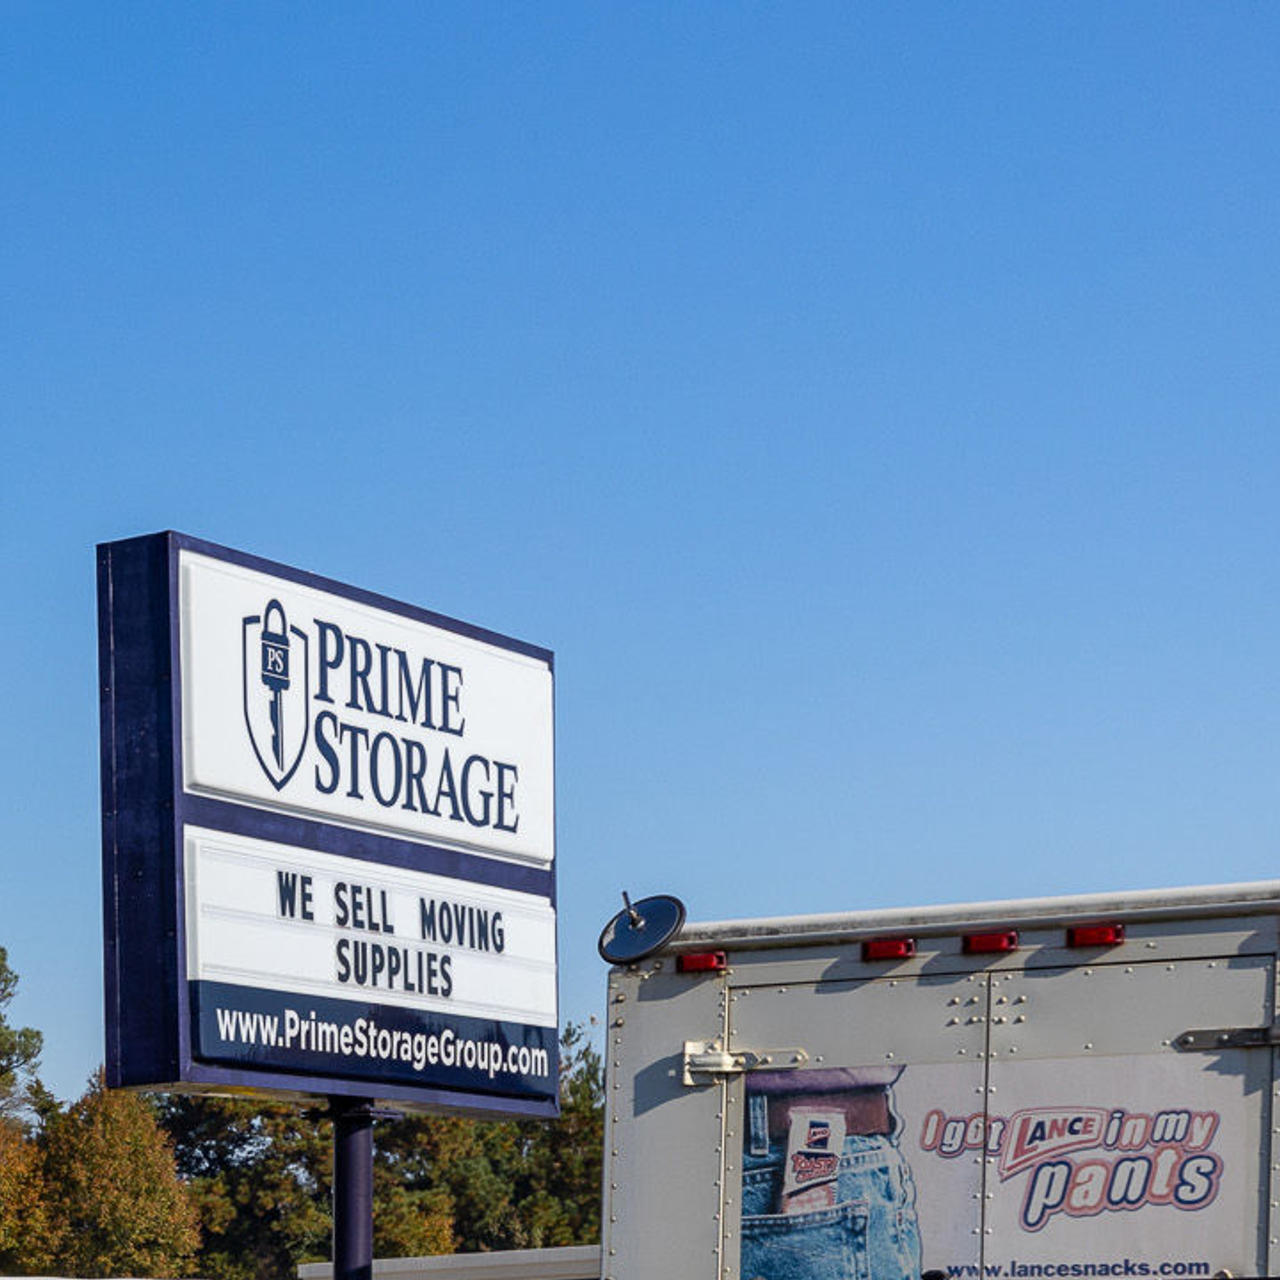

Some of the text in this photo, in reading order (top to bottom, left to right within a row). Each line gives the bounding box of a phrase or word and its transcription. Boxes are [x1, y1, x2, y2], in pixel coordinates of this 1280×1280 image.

[267, 647, 284, 673] PS
[313, 618, 465, 738] PRIME
[314, 709, 520, 834] STORAGE
[277, 869, 505, 954] WE SELL MOVING
[336, 938, 453, 999] SUPPLIES
[216, 1007, 549, 1080] www.PrimeStorageGroup.com
[939, 1112, 1006, 1157] got
[1012, 1116, 1097, 1161] LANCE
[1104, 1109, 1151, 1149] in
[1150, 1109, 1219, 1151] my
[1022, 1146, 1222, 1230] pants
[946, 1258, 1210, 1279] www.lancesnacks.com
